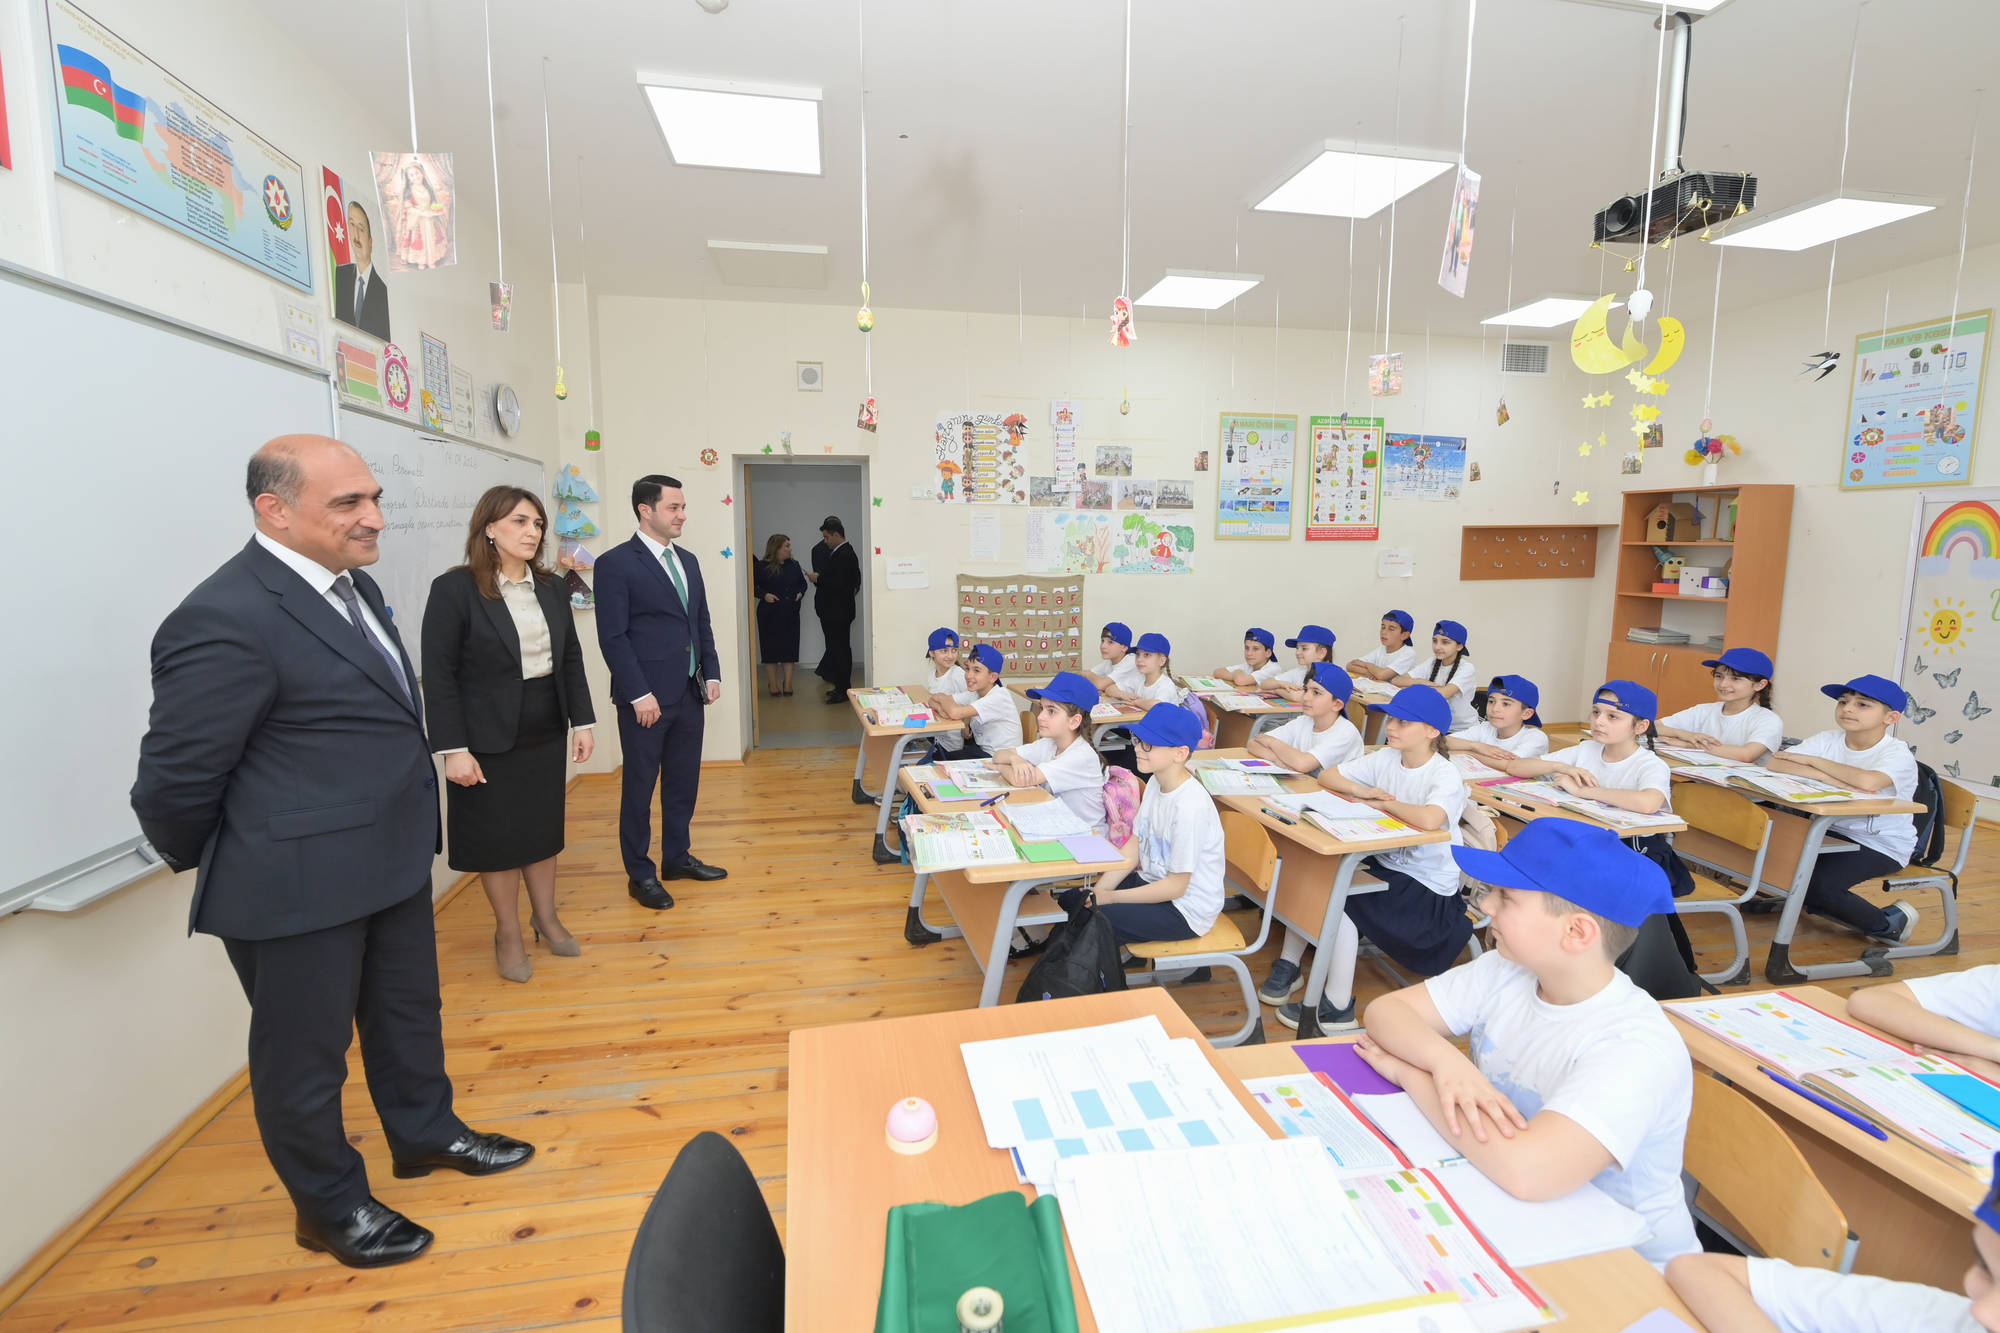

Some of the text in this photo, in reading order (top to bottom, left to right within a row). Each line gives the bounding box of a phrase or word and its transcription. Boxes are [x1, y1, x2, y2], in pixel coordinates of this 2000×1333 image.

[963, 594, 1076, 606] A B C Ç D E Ə F
[962, 616, 971, 625] G
[977, 615, 986, 627] Ğ
[993, 618, 1001, 628] H
[1010, 618, 1017, 627] X
[1026, 618, 1031, 627] I
[1071, 615, 1079, 625] K
[962, 639, 971, 650] Q
[991, 640, 1002, 649] M
[1008, 639, 1016, 648] N
[1024, 639, 1033, 648] O
[1039, 634, 1048, 650] Ö
[1056, 639, 1063, 648] P
[1070, 638, 1078, 648] R
[1009, 656, 1078, 672] U Ü V Y Z
